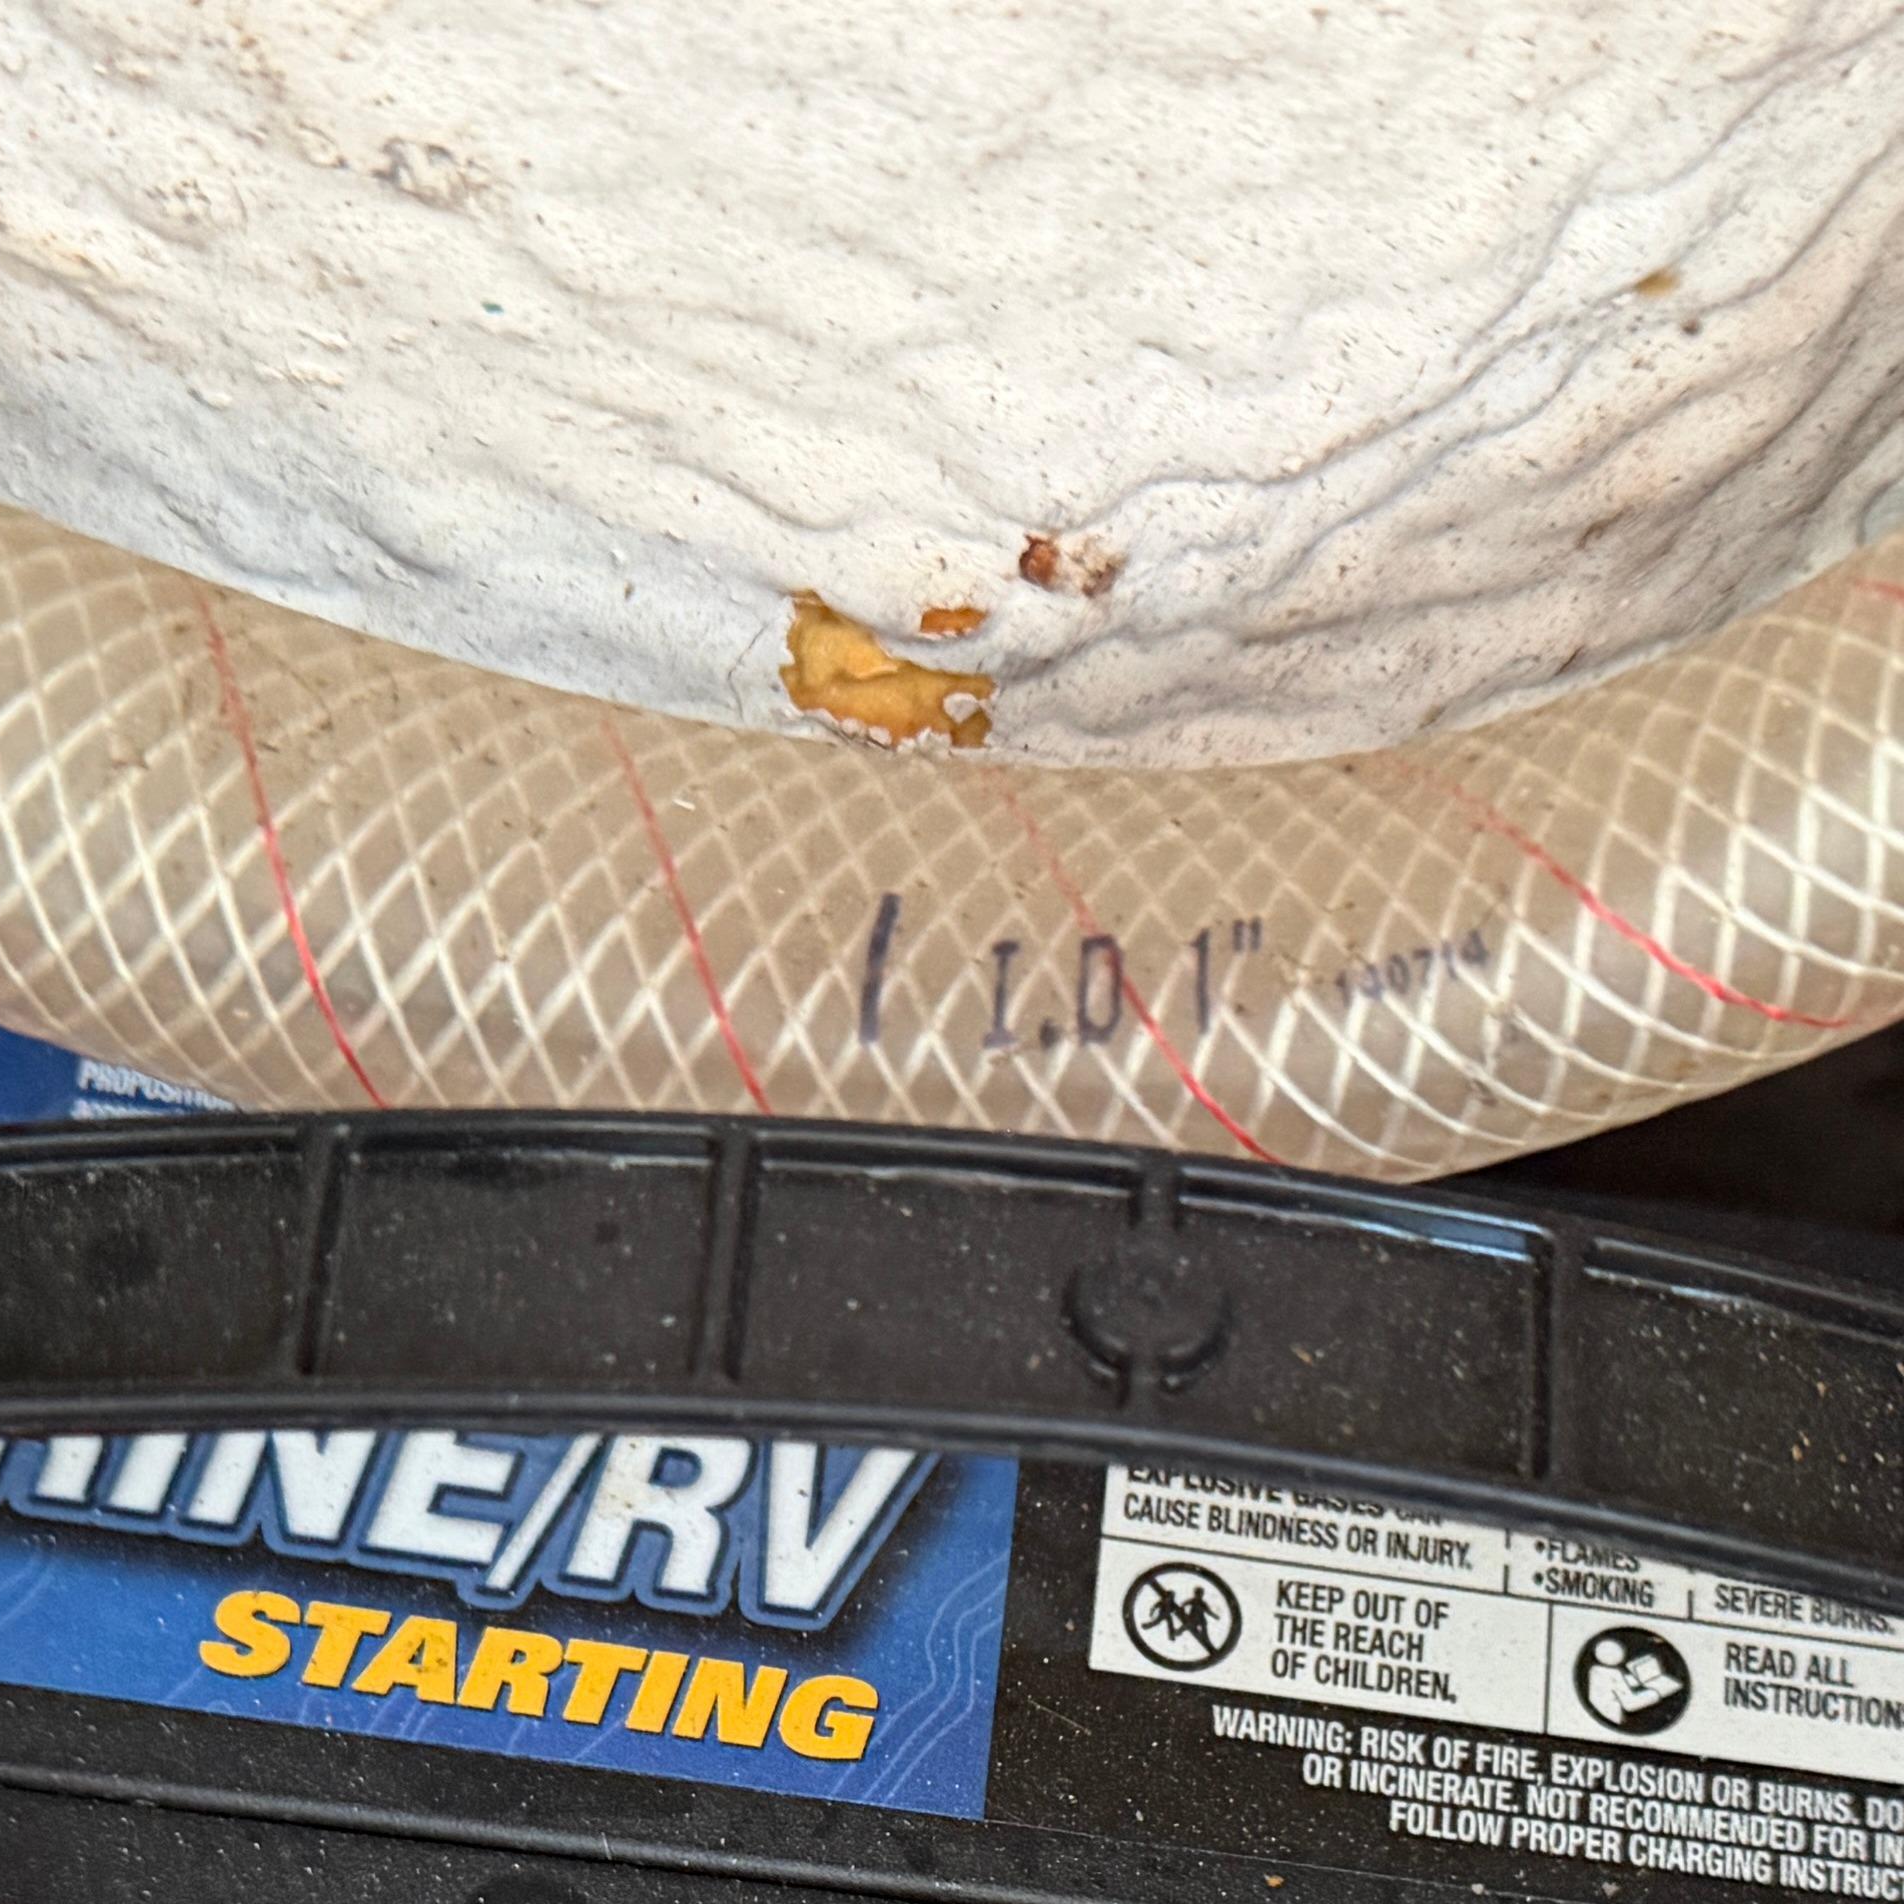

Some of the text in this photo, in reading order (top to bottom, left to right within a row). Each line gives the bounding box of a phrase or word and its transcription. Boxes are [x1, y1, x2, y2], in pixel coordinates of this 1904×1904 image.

[1124, 1493, 1474, 1570] CAUSE BLINDNESS OR INJURY.
[1275, 1577, 1450, 1629] KEEP OUT OF
[1715, 1583, 1808, 1623] SEVERE
[1274, 1612, 1425, 1663] THE REACH
[1724, 1641, 1855, 1689] READ ALL
[199, 1590, 880, 1761] STARTING
[1271, 1646, 1458, 1704] OF CHILDREN.
[1211, 1703, 1354, 1755] WARNING:
[1360, 1726, 1427, 1765] RISK
[1432, 1735, 1469, 1769] OF
[1475, 1743, 1545, 1785] FIRE,
[1550, 1751, 1705, 1804] EXPLOSION
[1711, 1773, 1751, 1812] OR
[1758, 1782, 1859, 1828] BURNS.
[1302, 1754, 1343, 1788] OR
[1350, 1759, 1519, 1814] INCINERATE.
[1526, 1785, 1584, 1821] NOT
[1589, 1793, 1810, 1853] RECOMMENDED
[1813, 1821, 1870, 1860] FOR
[1389, 1799, 1504, 1847] FOLLOW
[1511, 1817, 1621, 1863] PROPER
[1628, 1835, 1774, 1882] CHARGING
